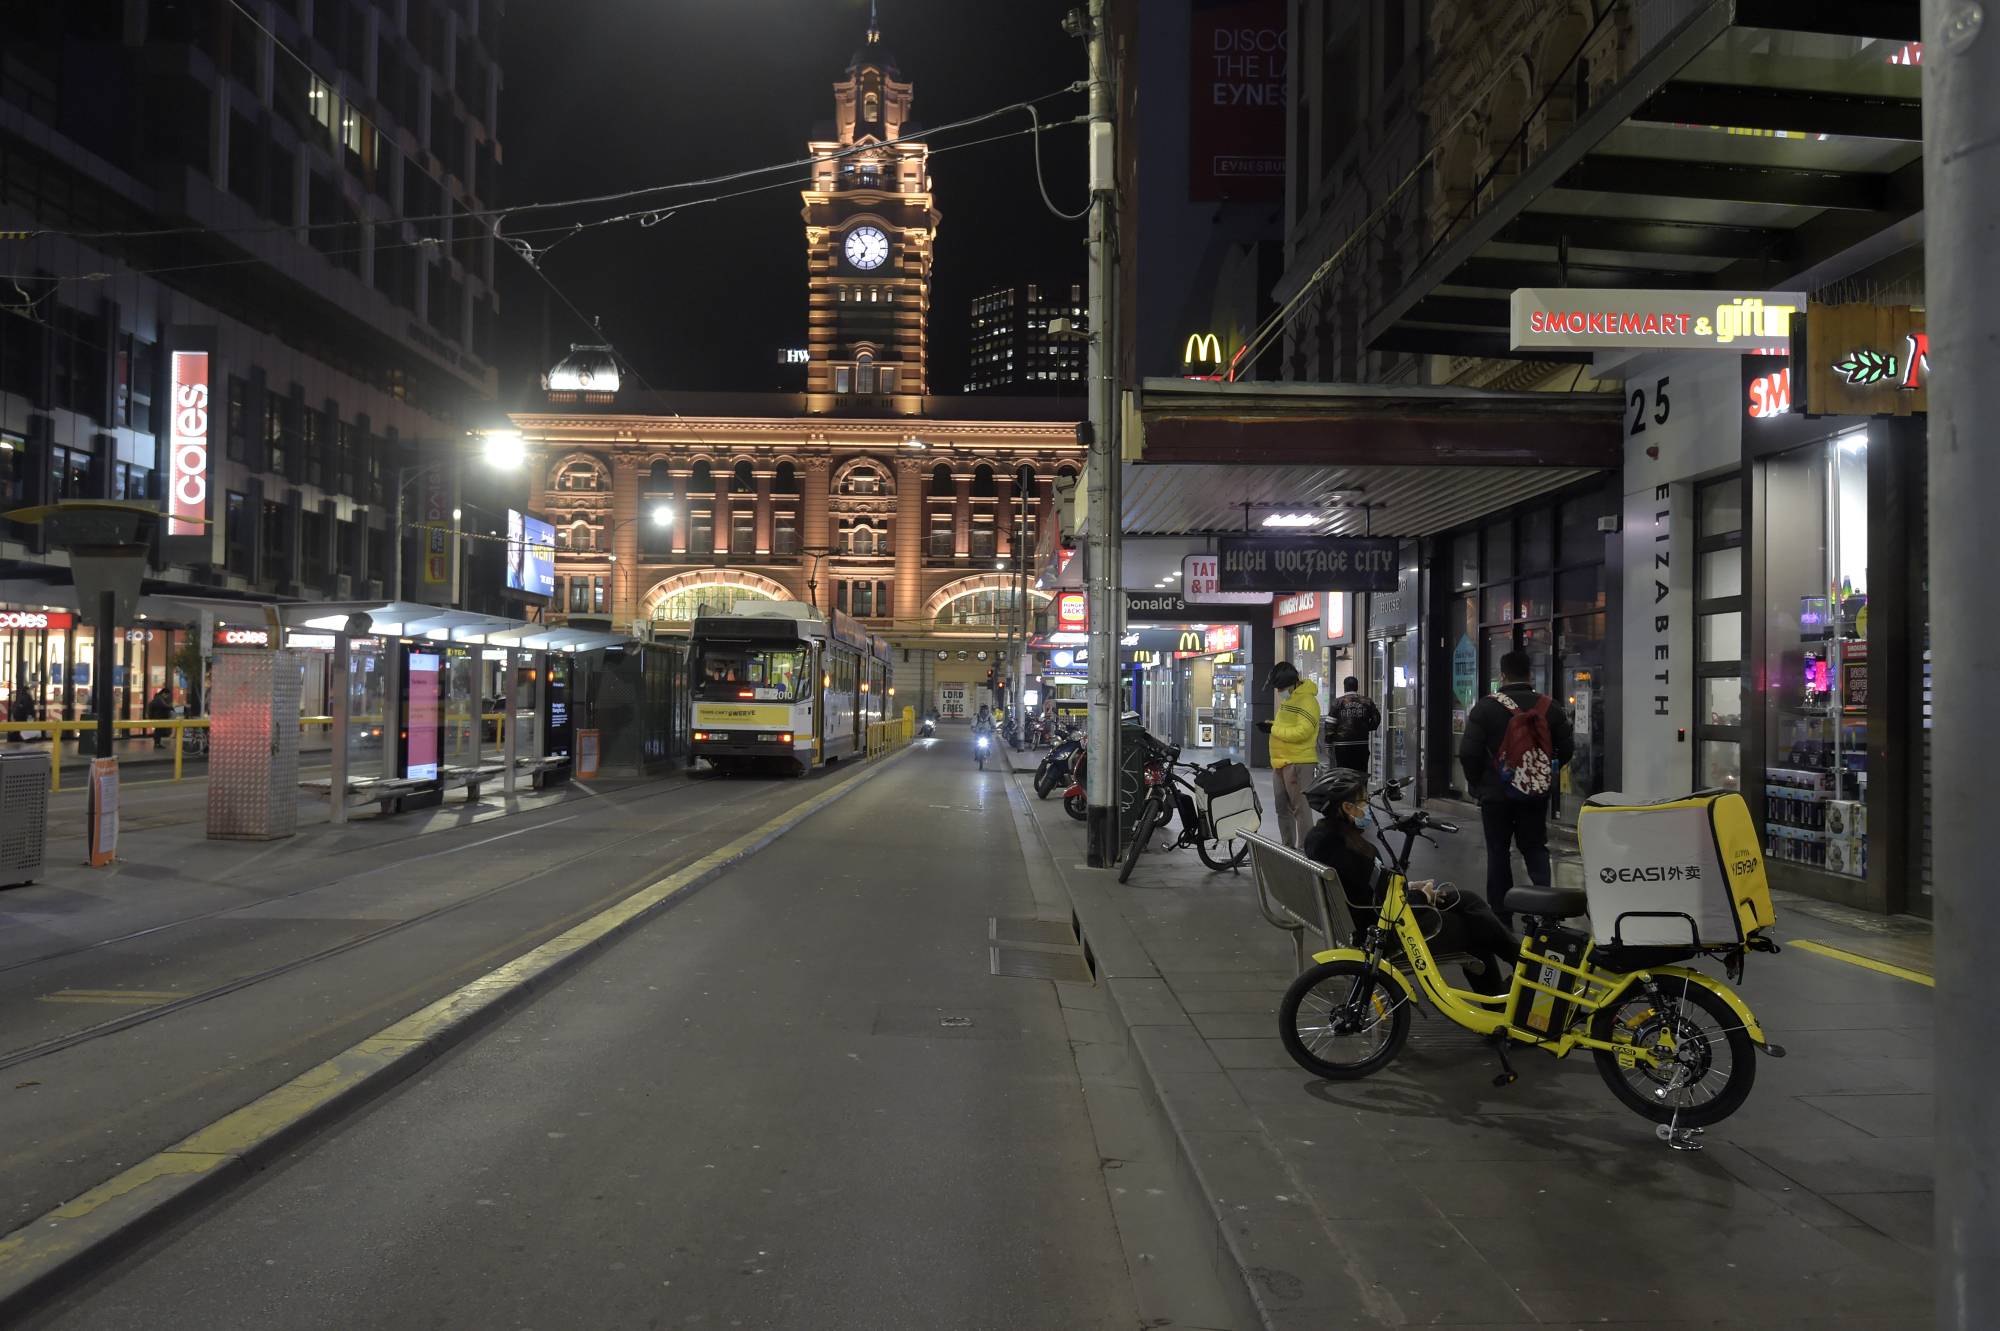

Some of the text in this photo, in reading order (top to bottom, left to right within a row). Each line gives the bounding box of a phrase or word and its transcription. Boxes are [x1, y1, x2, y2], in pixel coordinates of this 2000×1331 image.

[1213, 55, 1287, 78] THE L
[1221, 159, 1286, 173] EYNESBU
[1530, 298, 1796, 343] SMOKEMART & gift
[1749, 368, 1790, 418] SM
[1630, 376, 1670, 435] 25
[176, 383, 208, 505] coles
[1192, 562, 1216, 577] TAT
[1225, 550, 1392, 581] HIGH VOLTAGE CITY
[1127, 597, 1185, 610] onald's
[1655, 483, 1669, 716] ELIZABETH
[226, 630, 268, 644] coles
[1618, 866, 1701, 882] EASI 外卖
[1407, 936, 1421, 959] EASI
[1542, 967, 1555, 987] ASI
